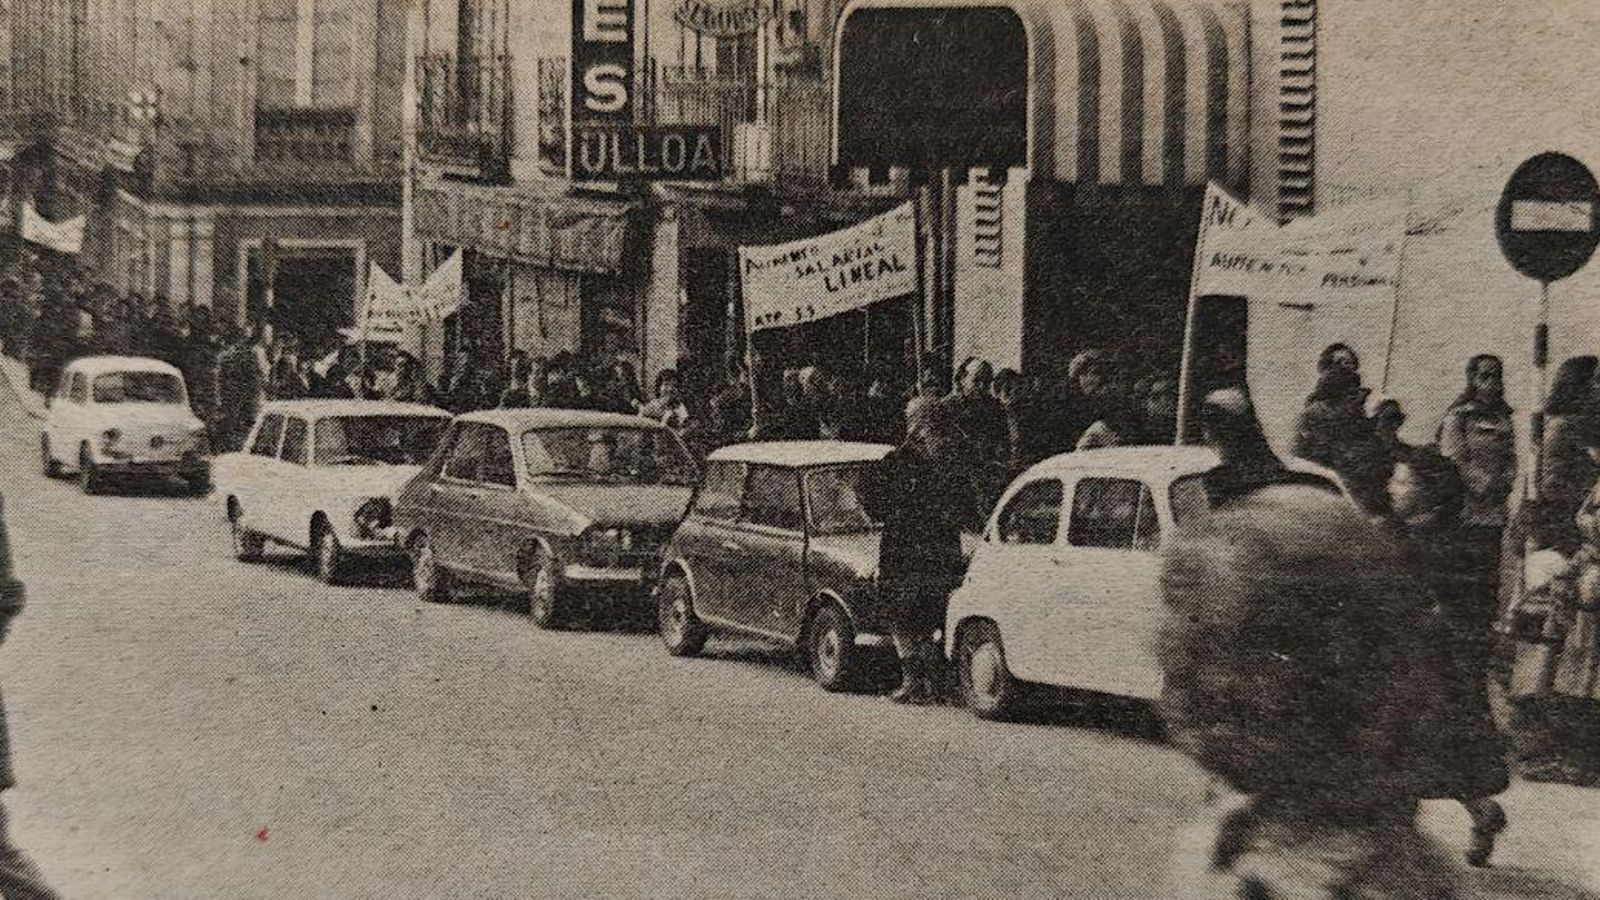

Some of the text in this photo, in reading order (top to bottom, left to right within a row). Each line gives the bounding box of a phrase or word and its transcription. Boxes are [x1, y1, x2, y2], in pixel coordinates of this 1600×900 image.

[580, 131, 718, 173] ULLOA
[795, 243, 885, 279] SALARIAL
[823, 253, 907, 294] LINEAL
